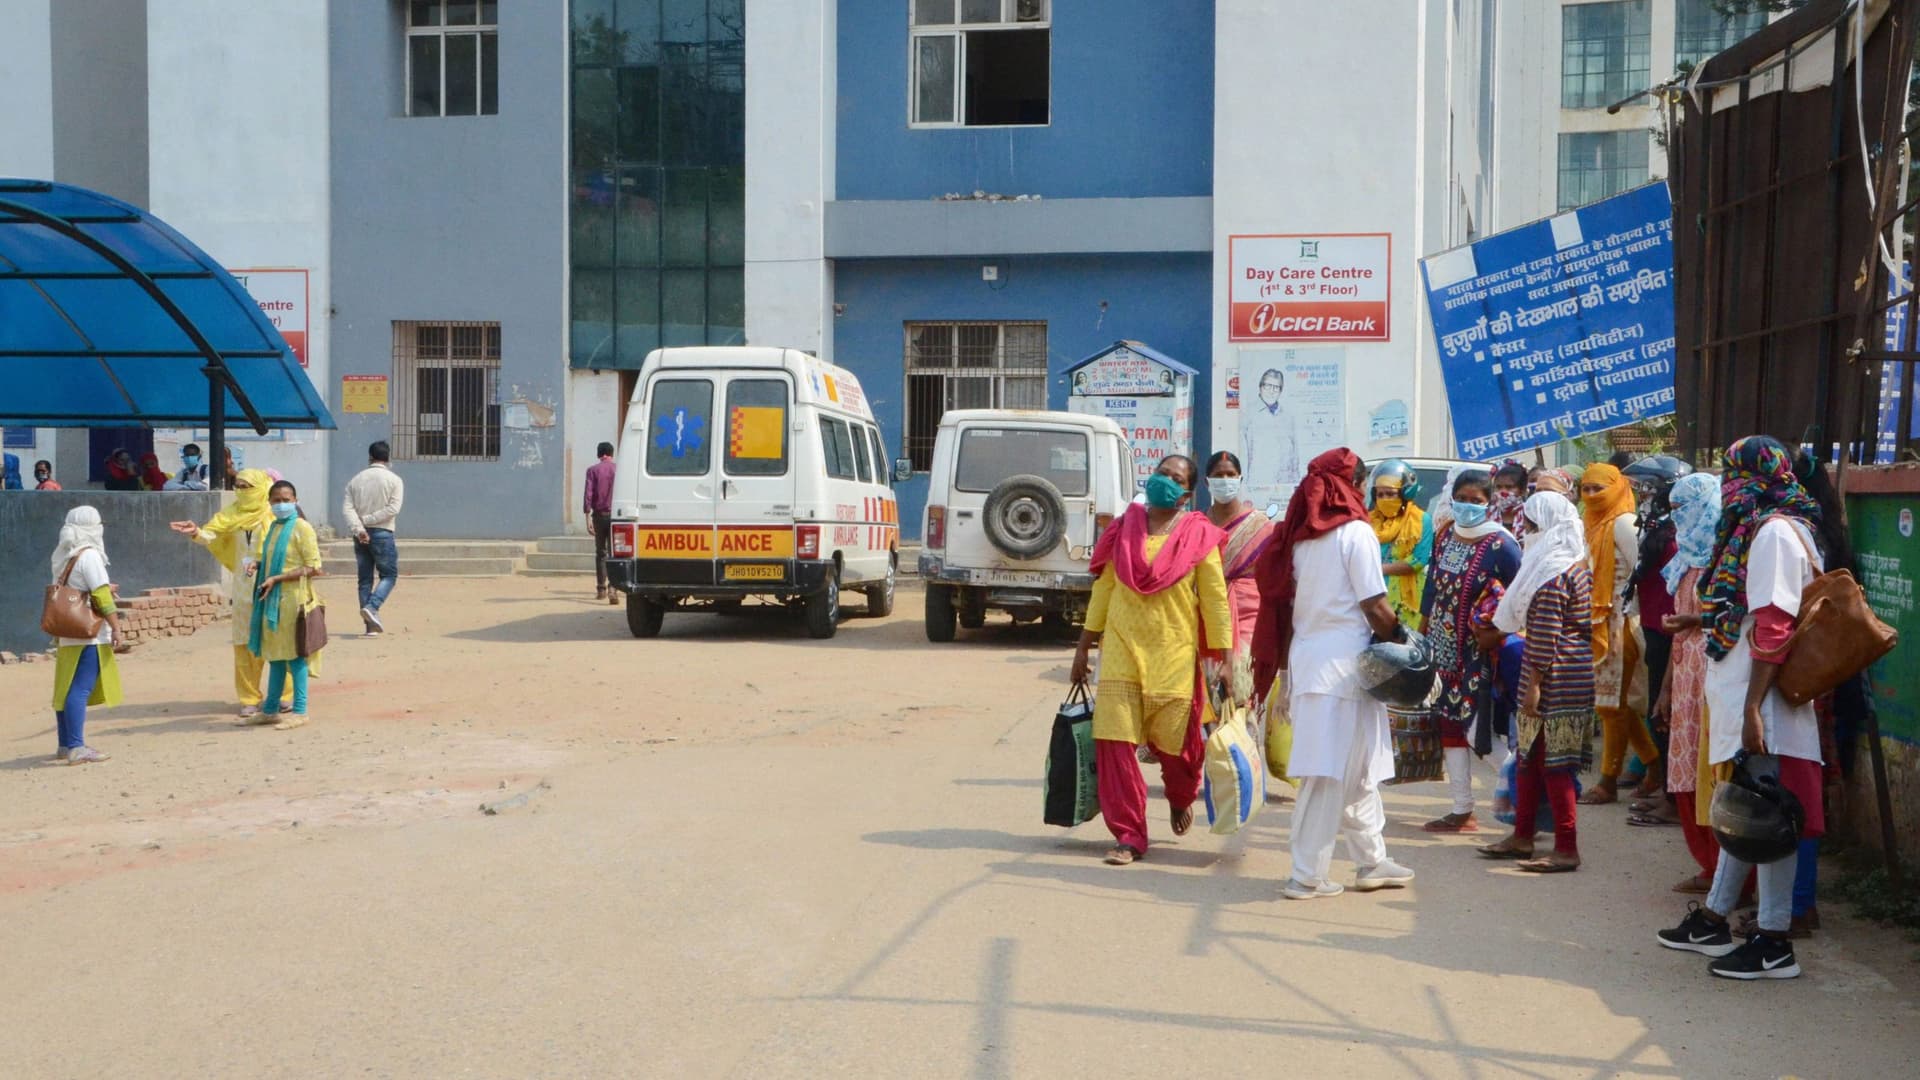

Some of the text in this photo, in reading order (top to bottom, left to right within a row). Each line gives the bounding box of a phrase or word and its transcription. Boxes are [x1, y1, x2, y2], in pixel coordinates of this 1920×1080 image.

[1475, 269, 1510, 287] सरकार
[1529, 255, 1554, 271] राज्य
[1554, 244, 1591, 263] सरकार
[1592, 239, 1604, 251] के
[1645, 222, 1656, 235] से
[1564, 248, 1624, 274] सामुदायिक
[1246, 266, 1373, 282] Day Care Centre
[1284, 285, 1294, 295] &
[1299, 283, 1316, 296] 3rd
[1320, 284, 1359, 297] Floor)
[1527, 287, 1550, 301] सदर
[256, 300, 294, 311] entre
[1489, 310, 1514, 335] की
[1515, 296, 1579, 328] देखभाल
[1579, 284, 1605, 308] की
[1606, 268, 1668, 304] समुचित
[1272, 316, 1325, 332] ICICI
[1326, 316, 1377, 332] Bank
[1508, 349, 1555, 371] मधुमेह
[1135, 427, 1168, 440] ATM
[1079, 784, 1087, 807] HAVE
